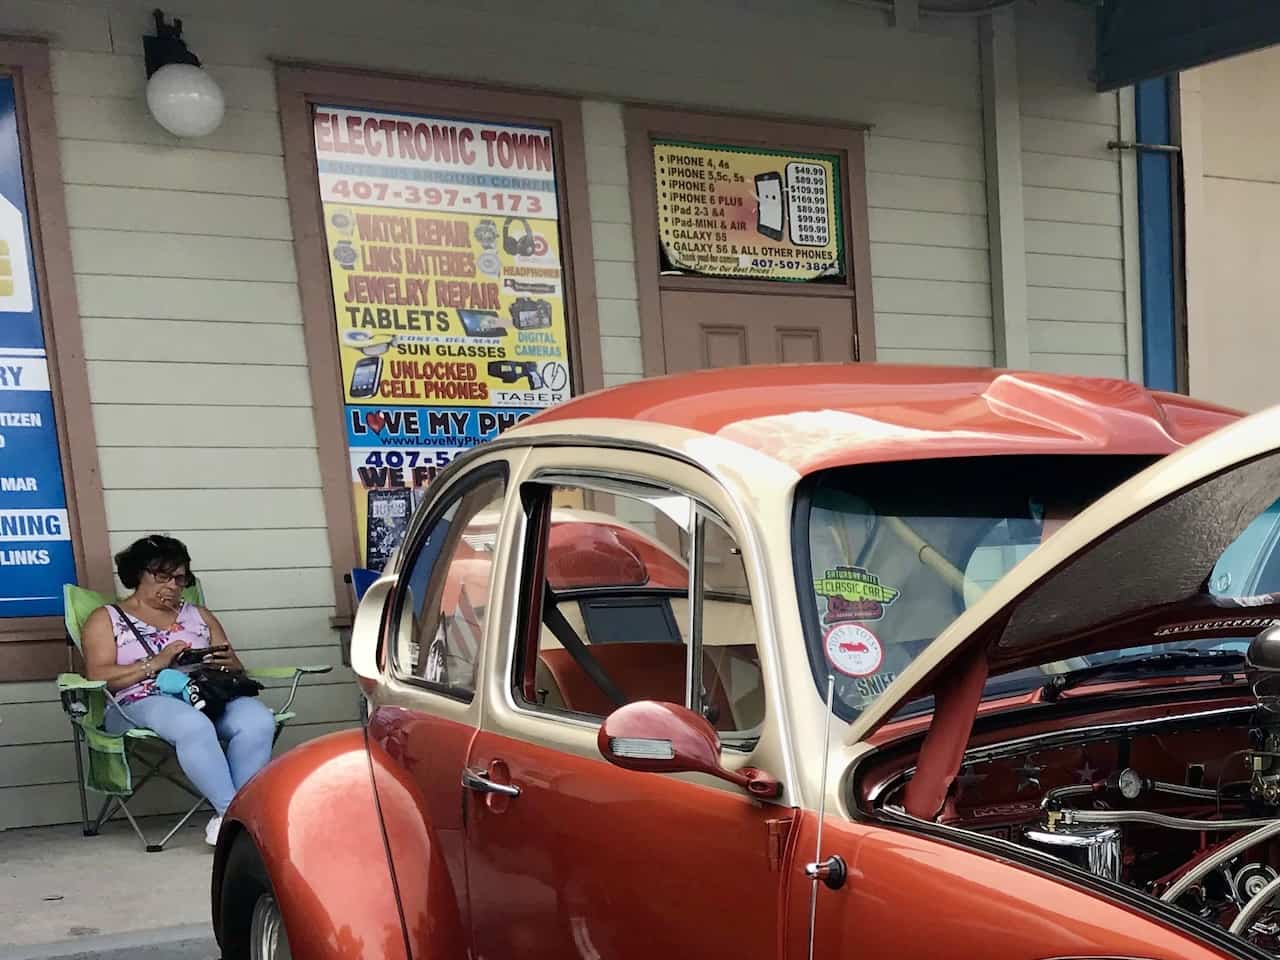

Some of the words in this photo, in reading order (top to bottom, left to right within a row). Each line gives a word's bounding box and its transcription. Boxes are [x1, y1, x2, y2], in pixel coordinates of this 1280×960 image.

[313, 112, 476, 166] ELECTRONIC
[481, 130, 551, 172] TOWN
[667, 154, 704, 166] iPHONE
[668, 167, 705, 180] iPHONE
[669, 180, 706, 192] iPHONE
[331, 178, 543, 213] 407-397-1173
[670, 192, 707, 204] iPHONE
[719, 196, 743, 206] PLUS
[671, 204, 691, 215] iPad
[356, 213, 412, 243] WATCH
[415, 218, 471, 248] REPAIR
[730, 221, 747, 231] AIR
[672, 229, 712, 241] GALAXY
[673, 241, 713, 252] GALAXY
[741, 246, 758, 256] ALL
[761, 247, 793, 257] OTHER
[796, 248, 833, 260] PHONES
[361, 244, 402, 274] LINKS
[405, 247, 476, 278] BATTERIES
[344, 273, 430, 306] JEWELRY
[436, 279, 501, 311] REPAIR
[346, 307, 450, 331] TABLETS
[397, 344, 430, 356] SUN
[436, 345, 506, 358] GLASSES
[390, 360, 477, 381] UNLOCKED
[380, 380, 421, 399] CELL
[424, 381, 488, 400] PHONES
[497, 393, 562, 402] TASER
[429, 412, 469, 435] MY
[365, 451, 463, 468] 407-5
[1, 477, 38, 492] MAR
[357, 467, 406, 489] WE
[0, 549, 51, 566] LINKS
[826, 581, 861, 594] CLASSIC
[863, 584, 881, 599] CAR
